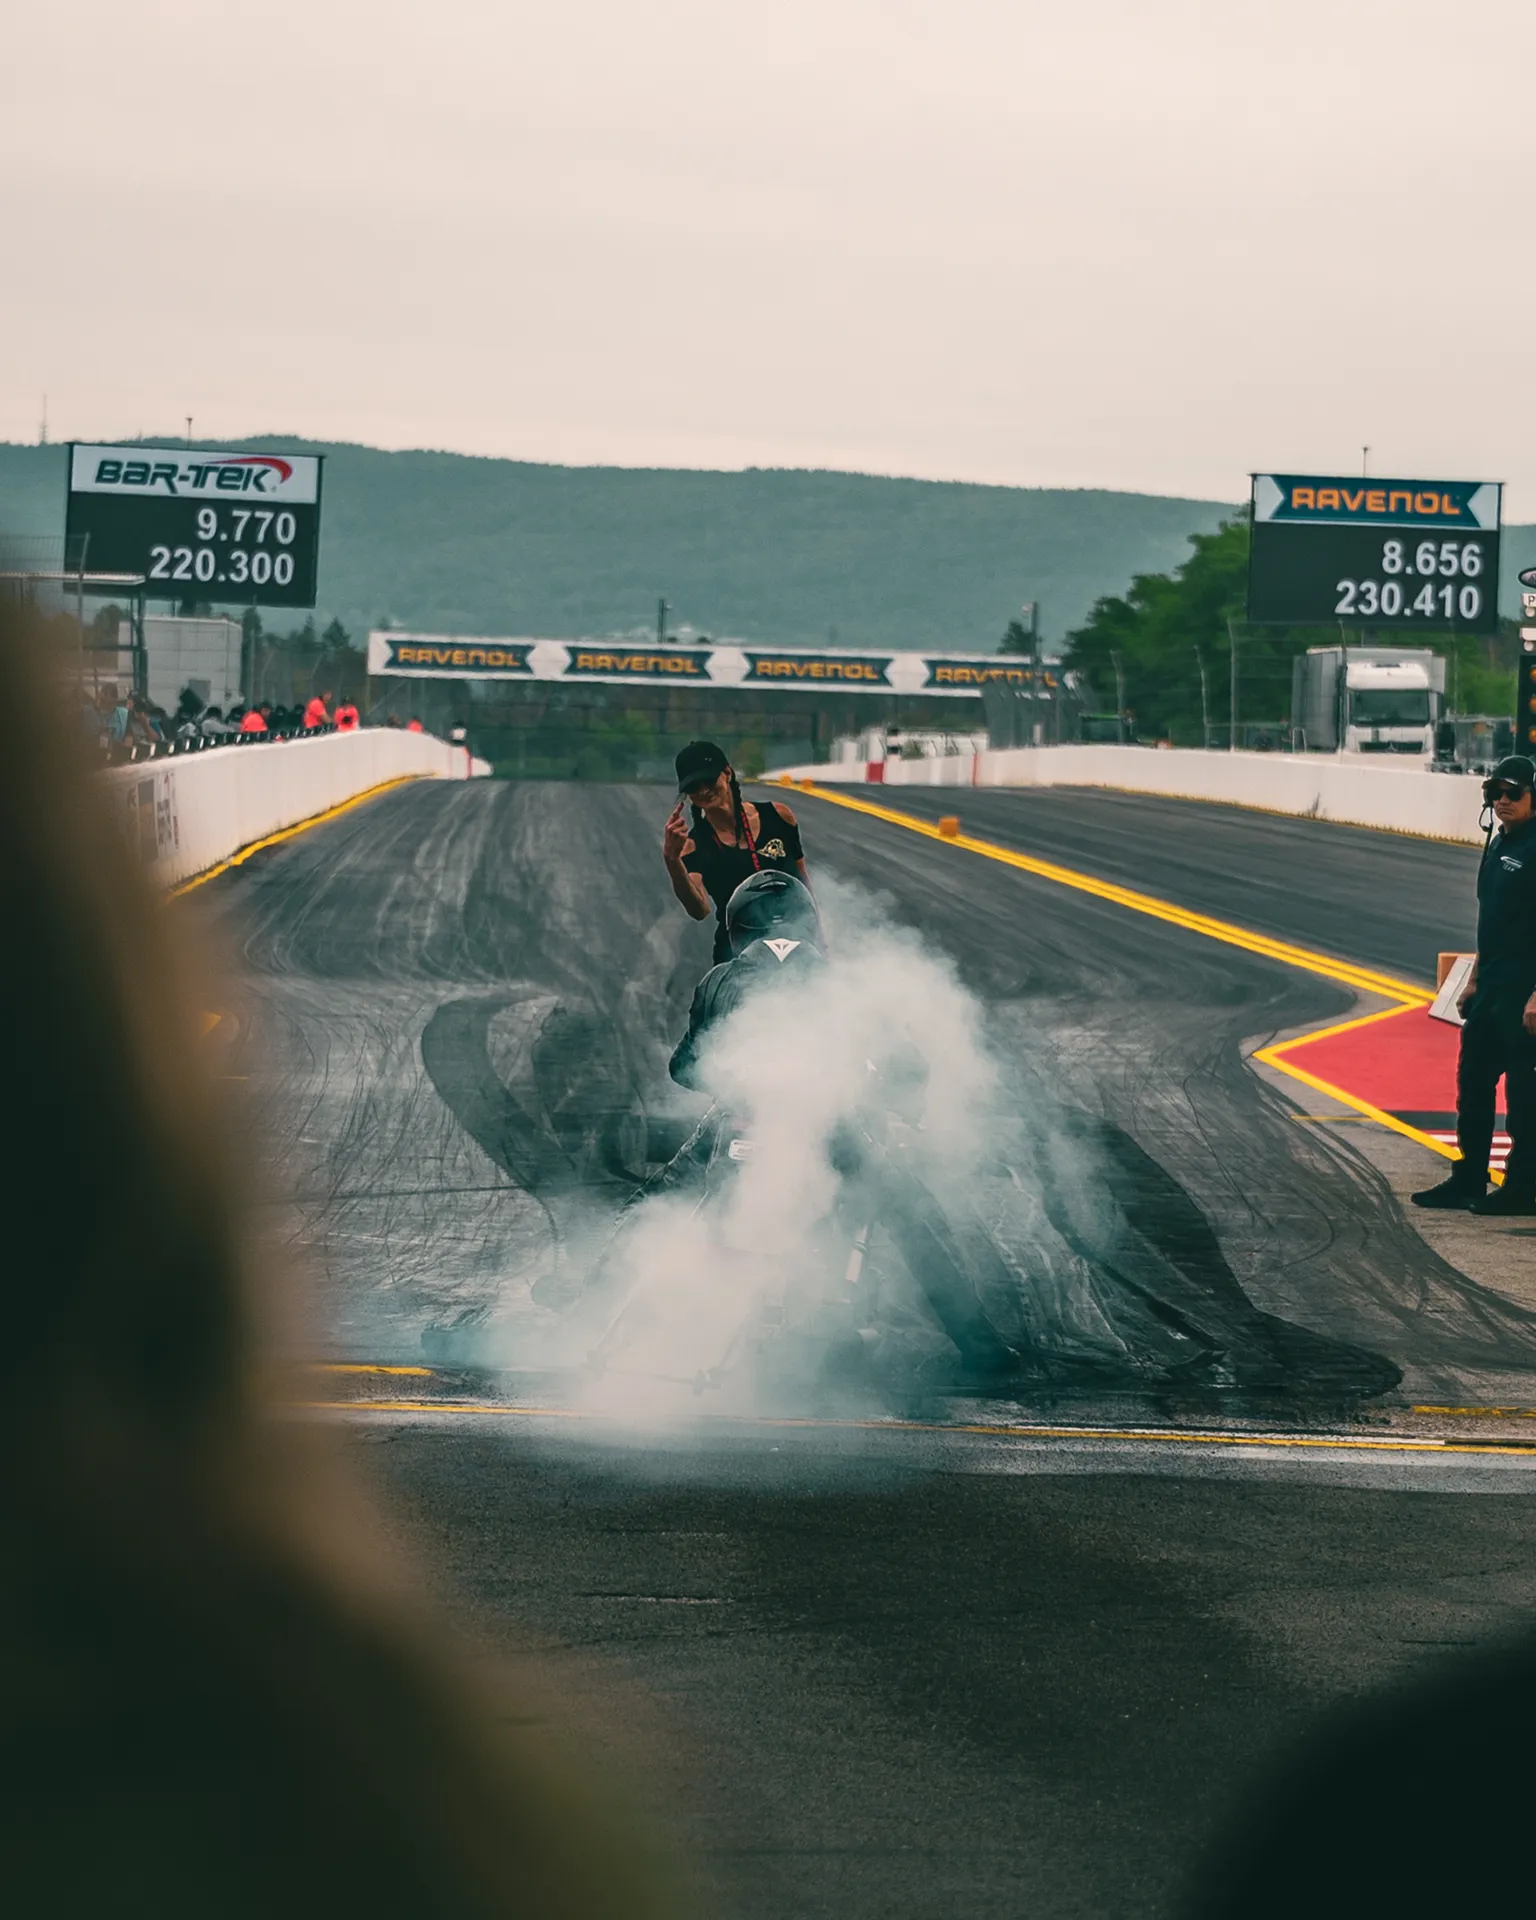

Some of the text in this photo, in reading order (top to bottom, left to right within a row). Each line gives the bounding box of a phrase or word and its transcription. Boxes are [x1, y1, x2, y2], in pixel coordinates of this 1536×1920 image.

[1292, 487, 1460, 515] RAVENOL
[197, 508, 297, 545] 9.770
[150, 546, 296, 586] 220.300
[1382, 541, 1481, 577] 8.656
[1335, 580, 1480, 620] 230.410
[398, 646, 521, 667] RAVENOL
[576, 653, 699, 673] RAVENOL
[755, 660, 879, 680] RAVENOL
